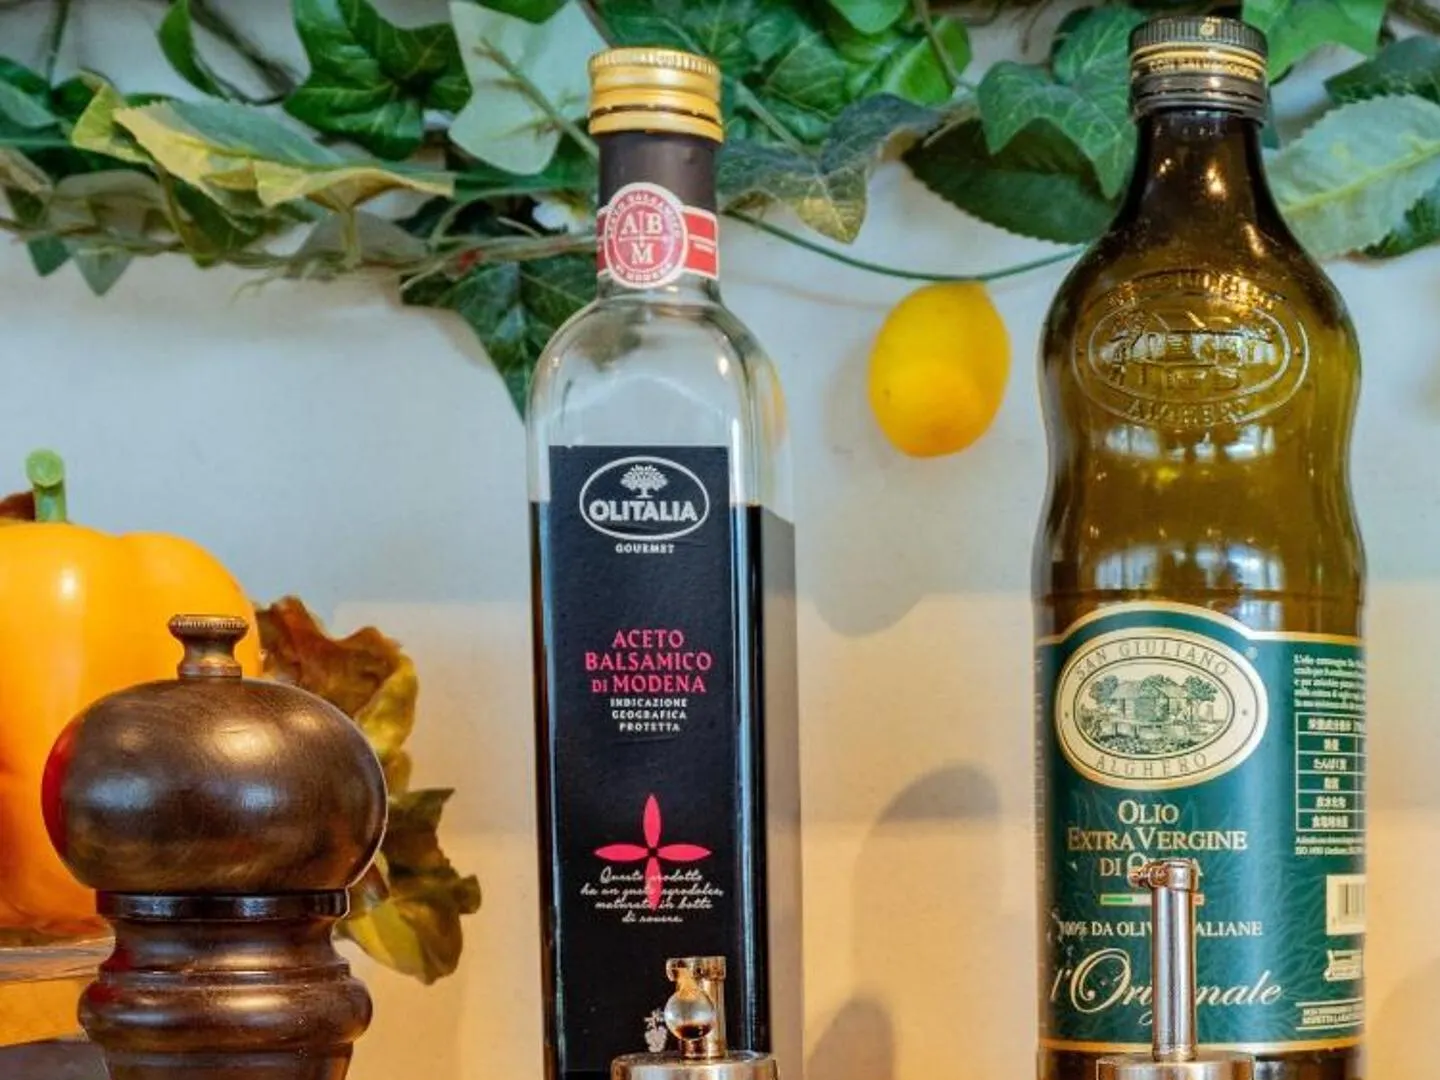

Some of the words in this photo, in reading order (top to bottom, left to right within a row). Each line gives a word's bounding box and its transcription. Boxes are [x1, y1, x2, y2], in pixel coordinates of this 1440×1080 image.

[589, 500, 698, 521] OLITALIA
[616, 543, 675, 554] GOURMET
[612, 629, 684, 649] ACETO
[585, 652, 712, 671] BALSAMICO
[1074, 650, 1108, 681] SAN
[1118, 638, 1230, 677] GIULIANO
[612, 675, 706, 693] MODENA
[610, 698, 687, 708] INDICAZIONE
[612, 710, 687, 720] GEOGRAFICA
[619, 722, 680, 732] PROTETTA
[1095, 752, 1208, 779] ALGHERO
[1118, 799, 1180, 826] OLIO
[1067, 829, 1132, 851] EXTRA
[1135, 827, 1248, 852] VERGINE
[1100, 857, 1121, 876] DI
[1091, 921, 1114, 937] DA
[1196, 920, 1263, 938] ALIANE
